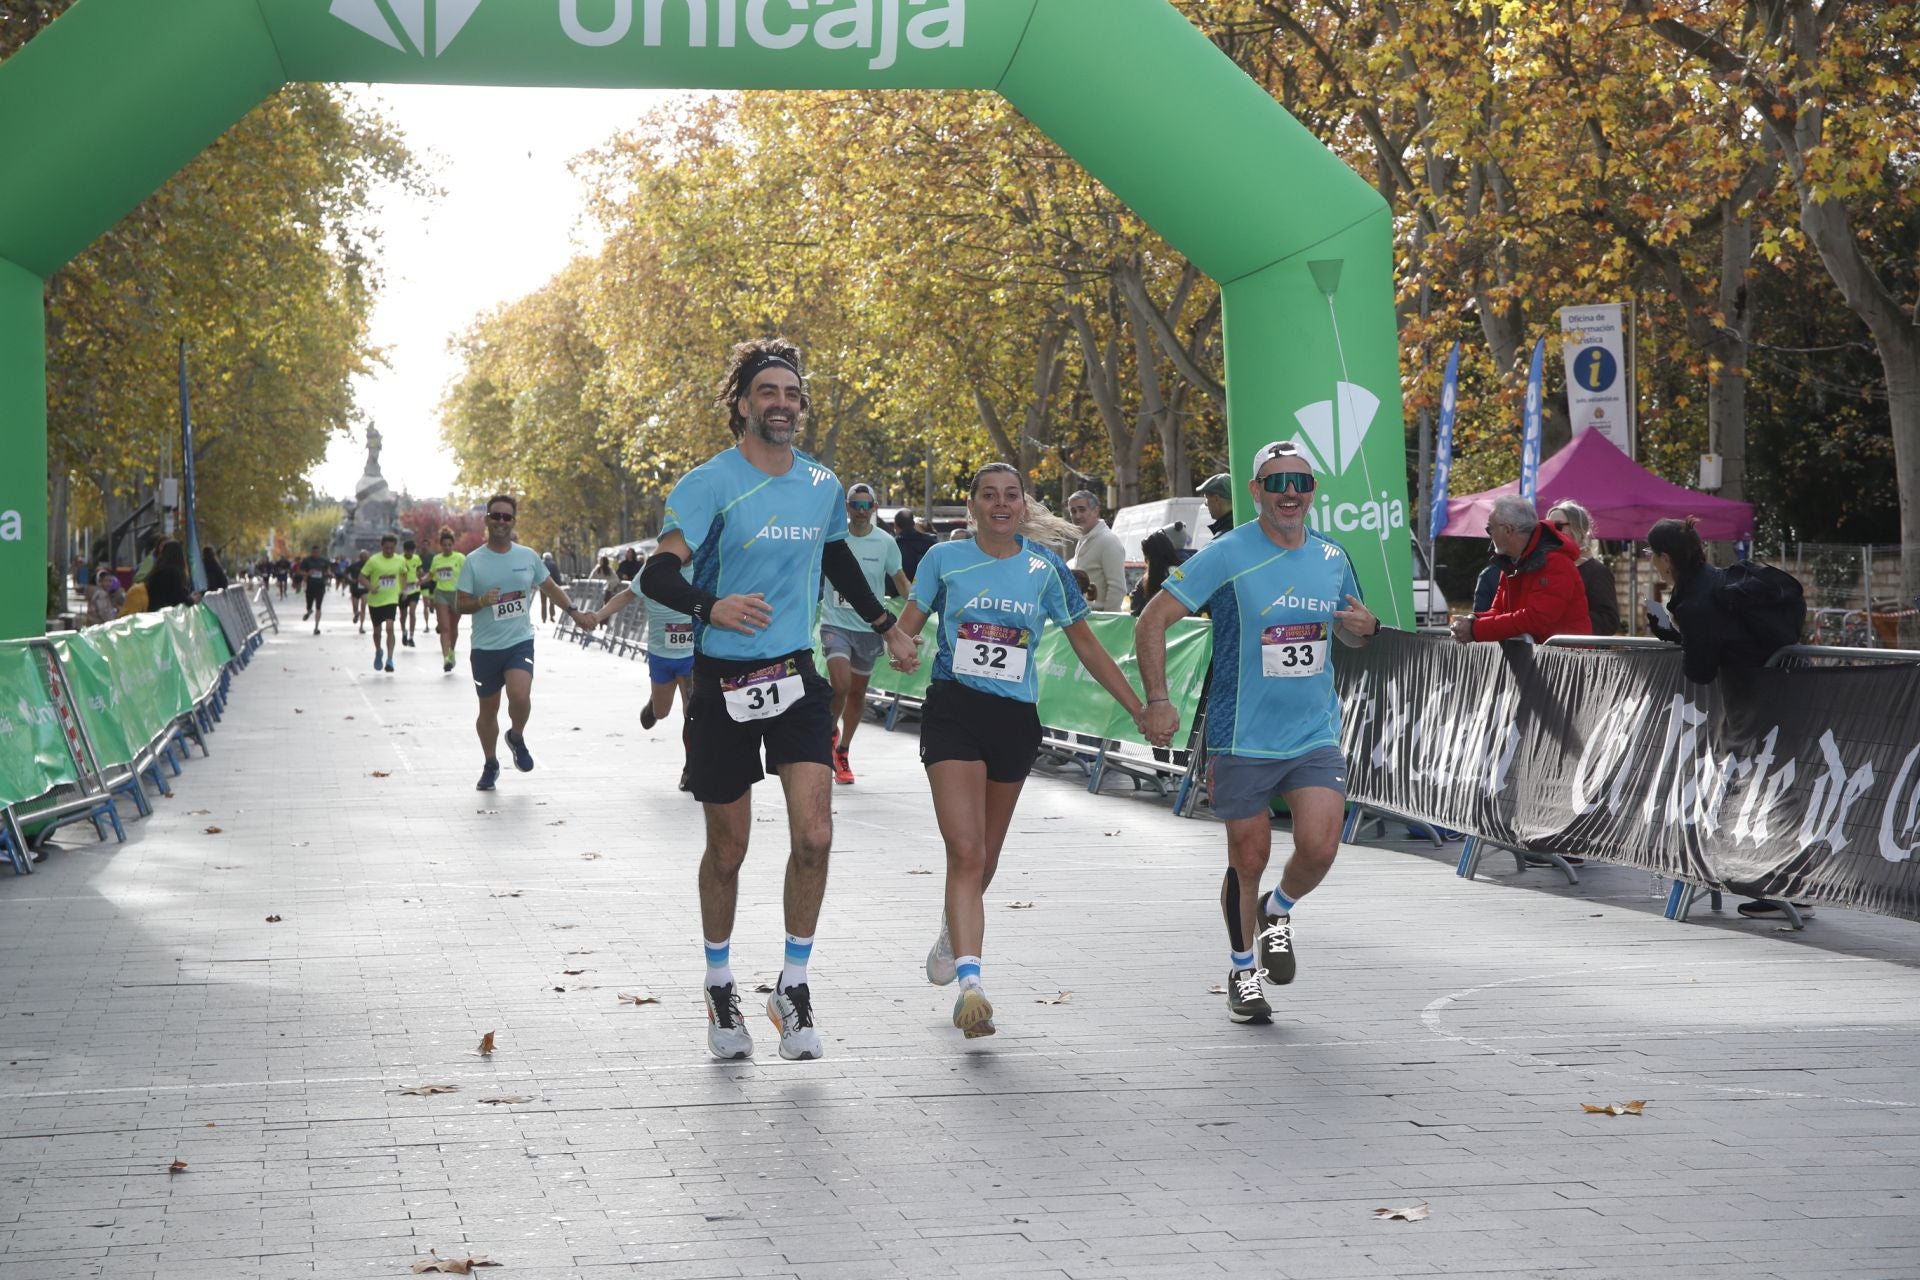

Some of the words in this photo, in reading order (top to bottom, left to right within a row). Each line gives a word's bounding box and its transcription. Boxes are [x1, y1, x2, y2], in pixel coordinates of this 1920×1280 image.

[1569, 314, 1594, 323] Oficina
[755, 525, 821, 540] ADIENT
[498, 600, 522, 615] 803
[964, 597, 1035, 616] ADIENT
[1272, 595, 1337, 612] ADIENT
[670, 632, 694, 644] 804
[973, 644, 1007, 668] 32
[1282, 645, 1314, 667] 33
[746, 682, 780, 710] 31
[1796, 727, 1876, 856] de
